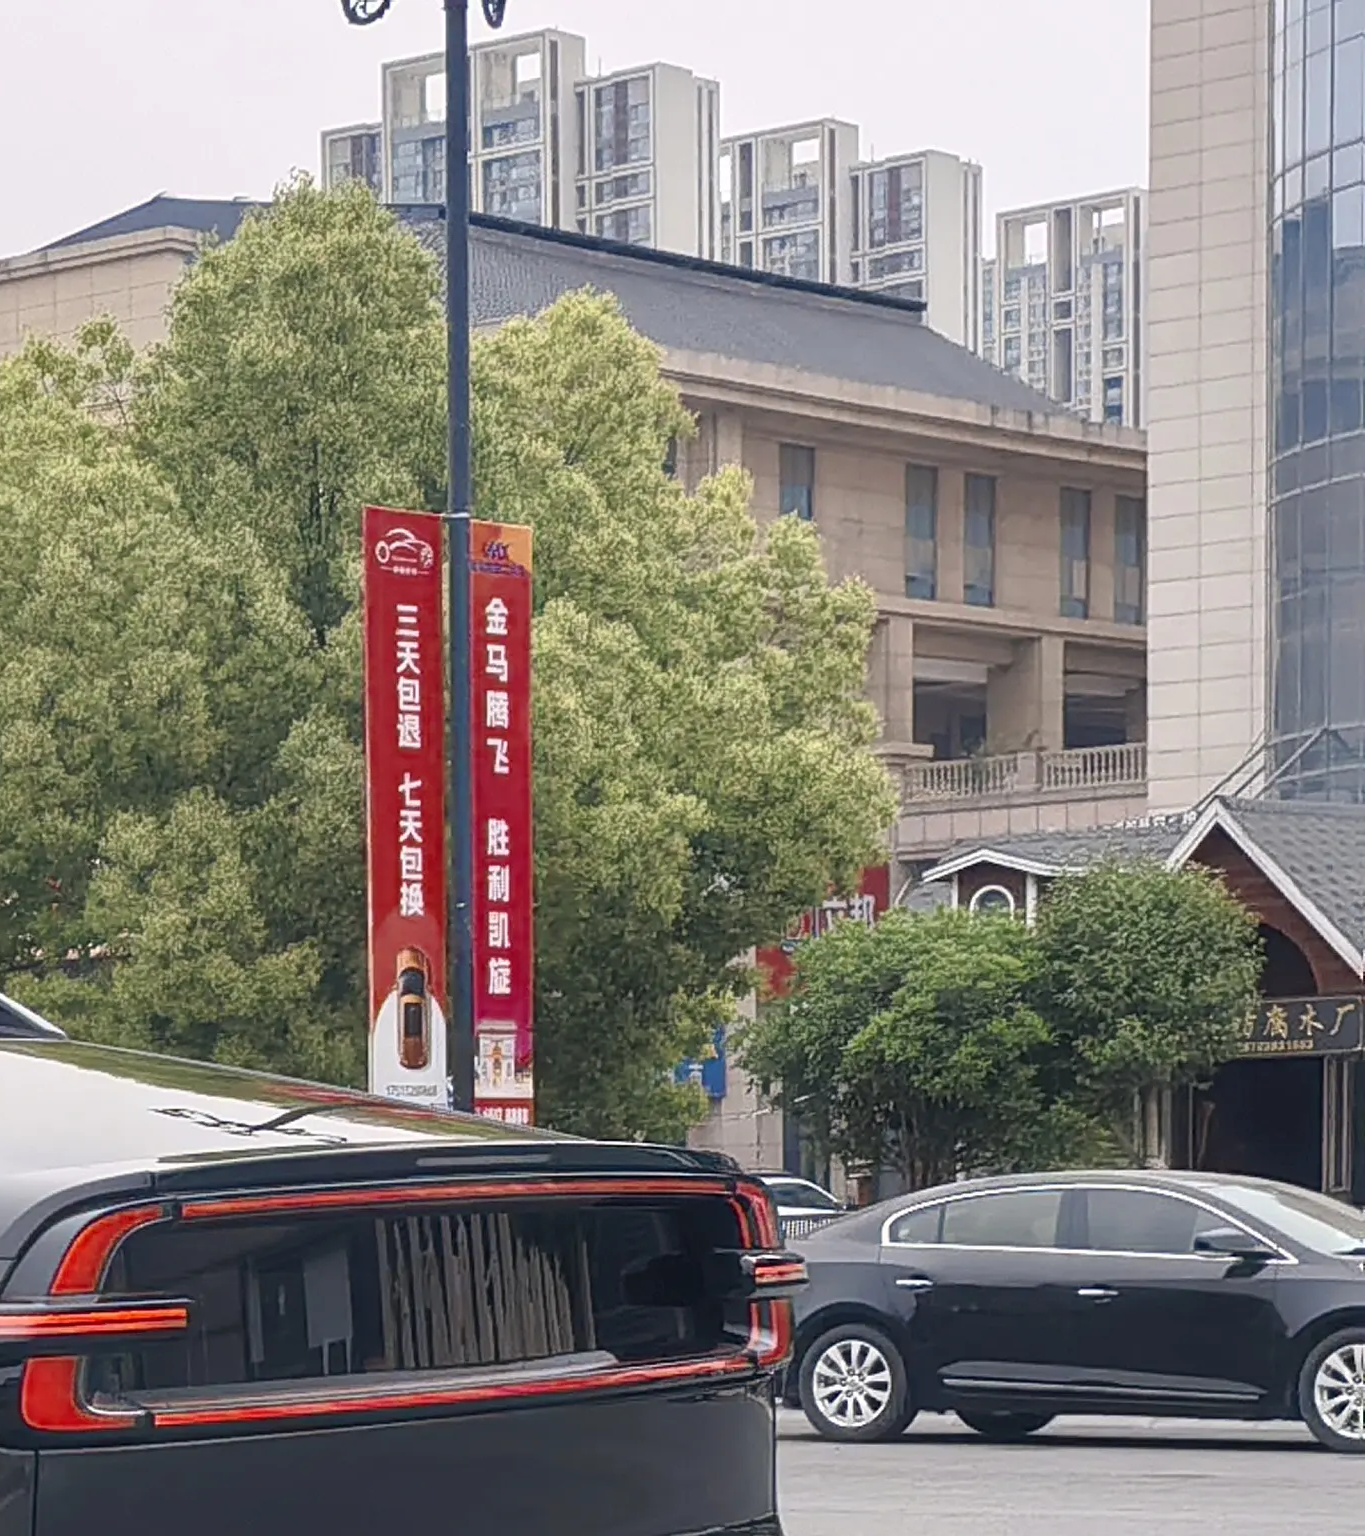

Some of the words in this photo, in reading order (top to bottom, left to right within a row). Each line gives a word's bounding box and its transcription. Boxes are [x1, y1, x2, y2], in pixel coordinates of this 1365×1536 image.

[395, 603, 422, 749] 三天包退
[397, 771, 425, 917] 七天包换
